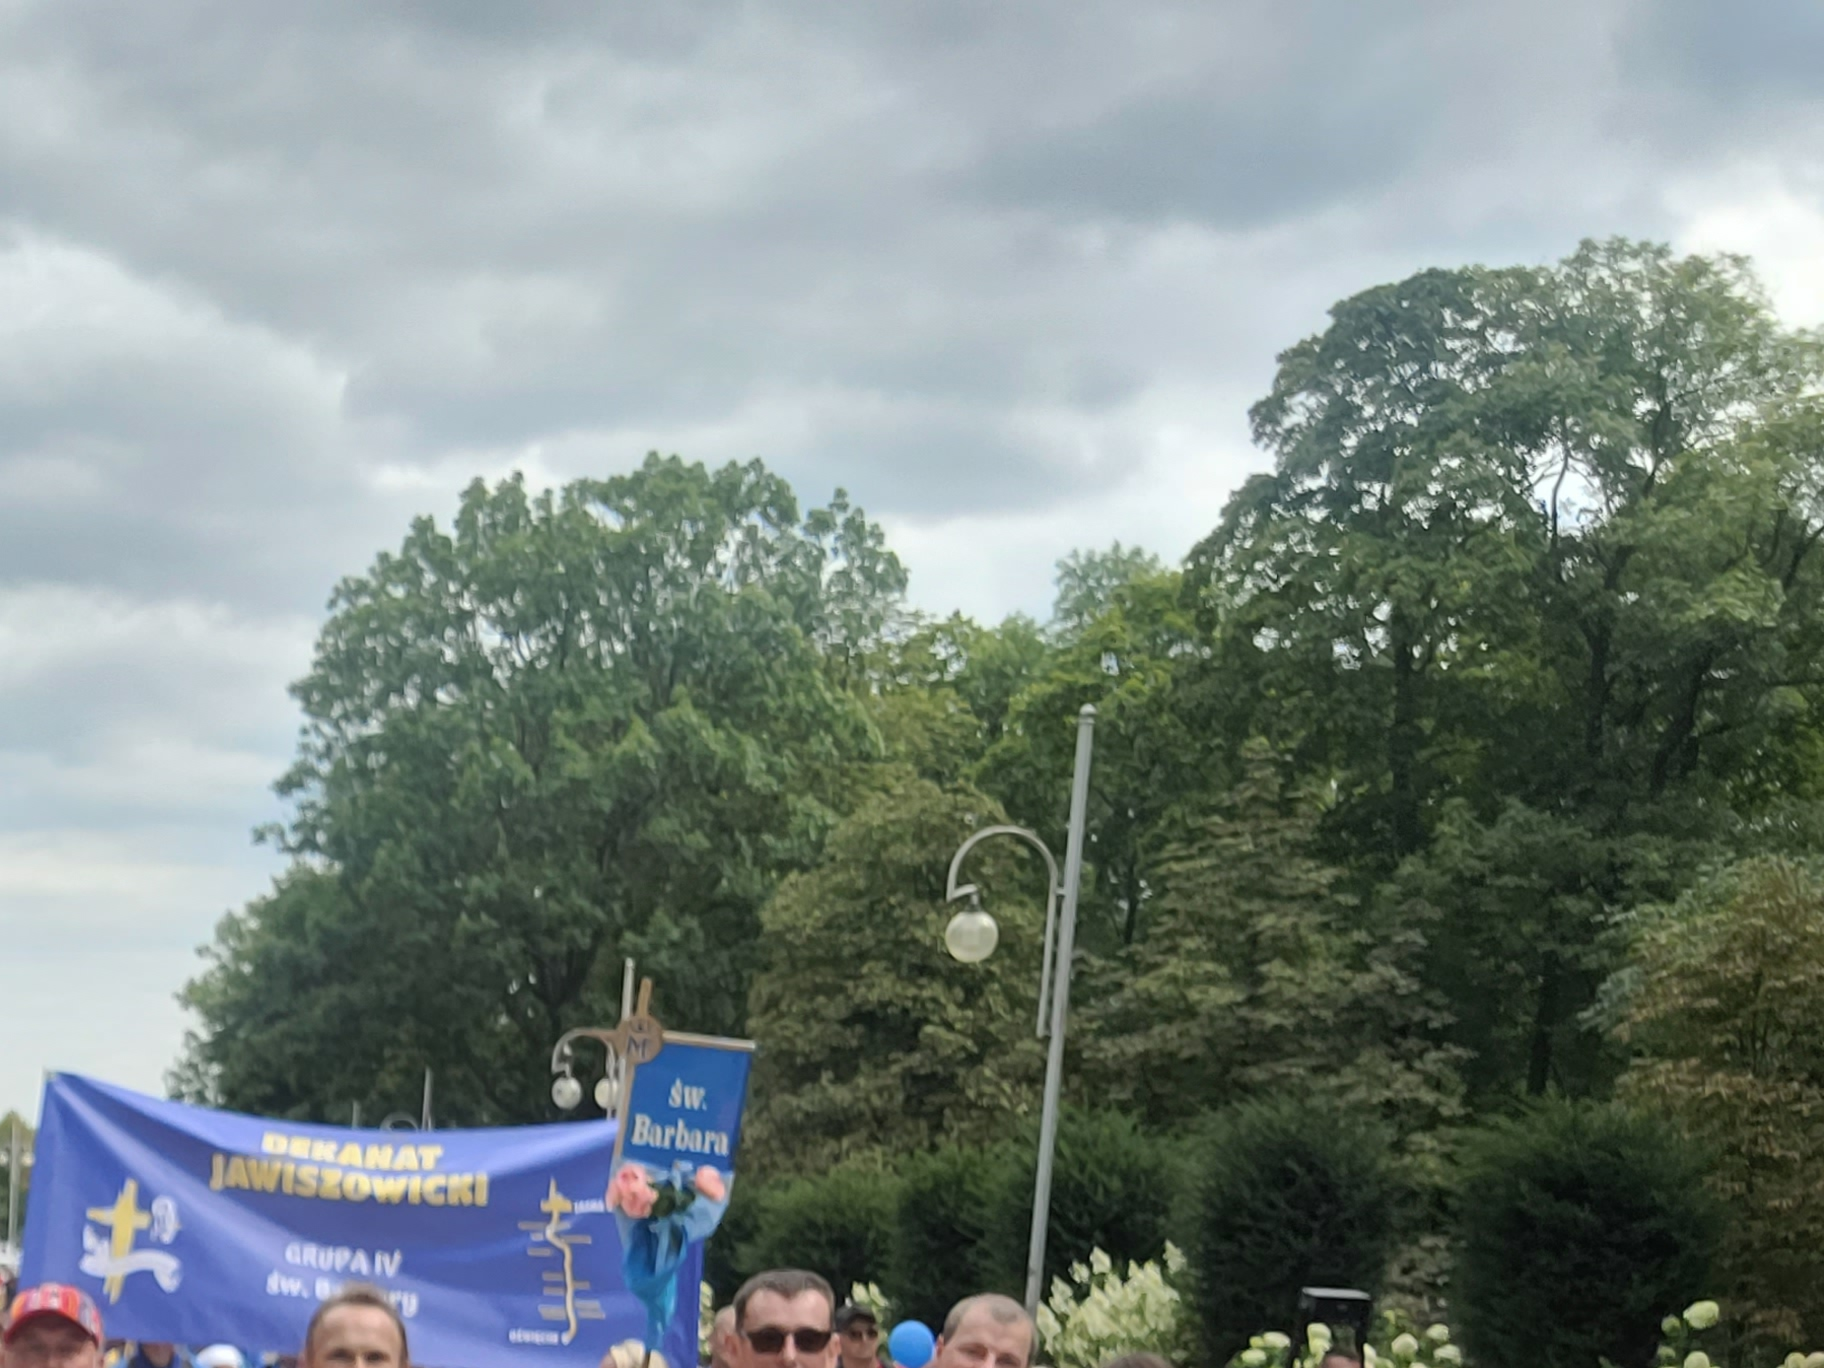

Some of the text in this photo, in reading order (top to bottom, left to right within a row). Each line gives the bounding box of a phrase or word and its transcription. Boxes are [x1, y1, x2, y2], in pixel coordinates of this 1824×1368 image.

[668, 1077, 707, 1111] św.
[261, 1131, 444, 1171] DEKANAT
[631, 1113, 729, 1158] Barbara
[209, 1152, 489, 1207] JAWISZOWICKI
[285, 1242, 402, 1278] GRUPA IV
